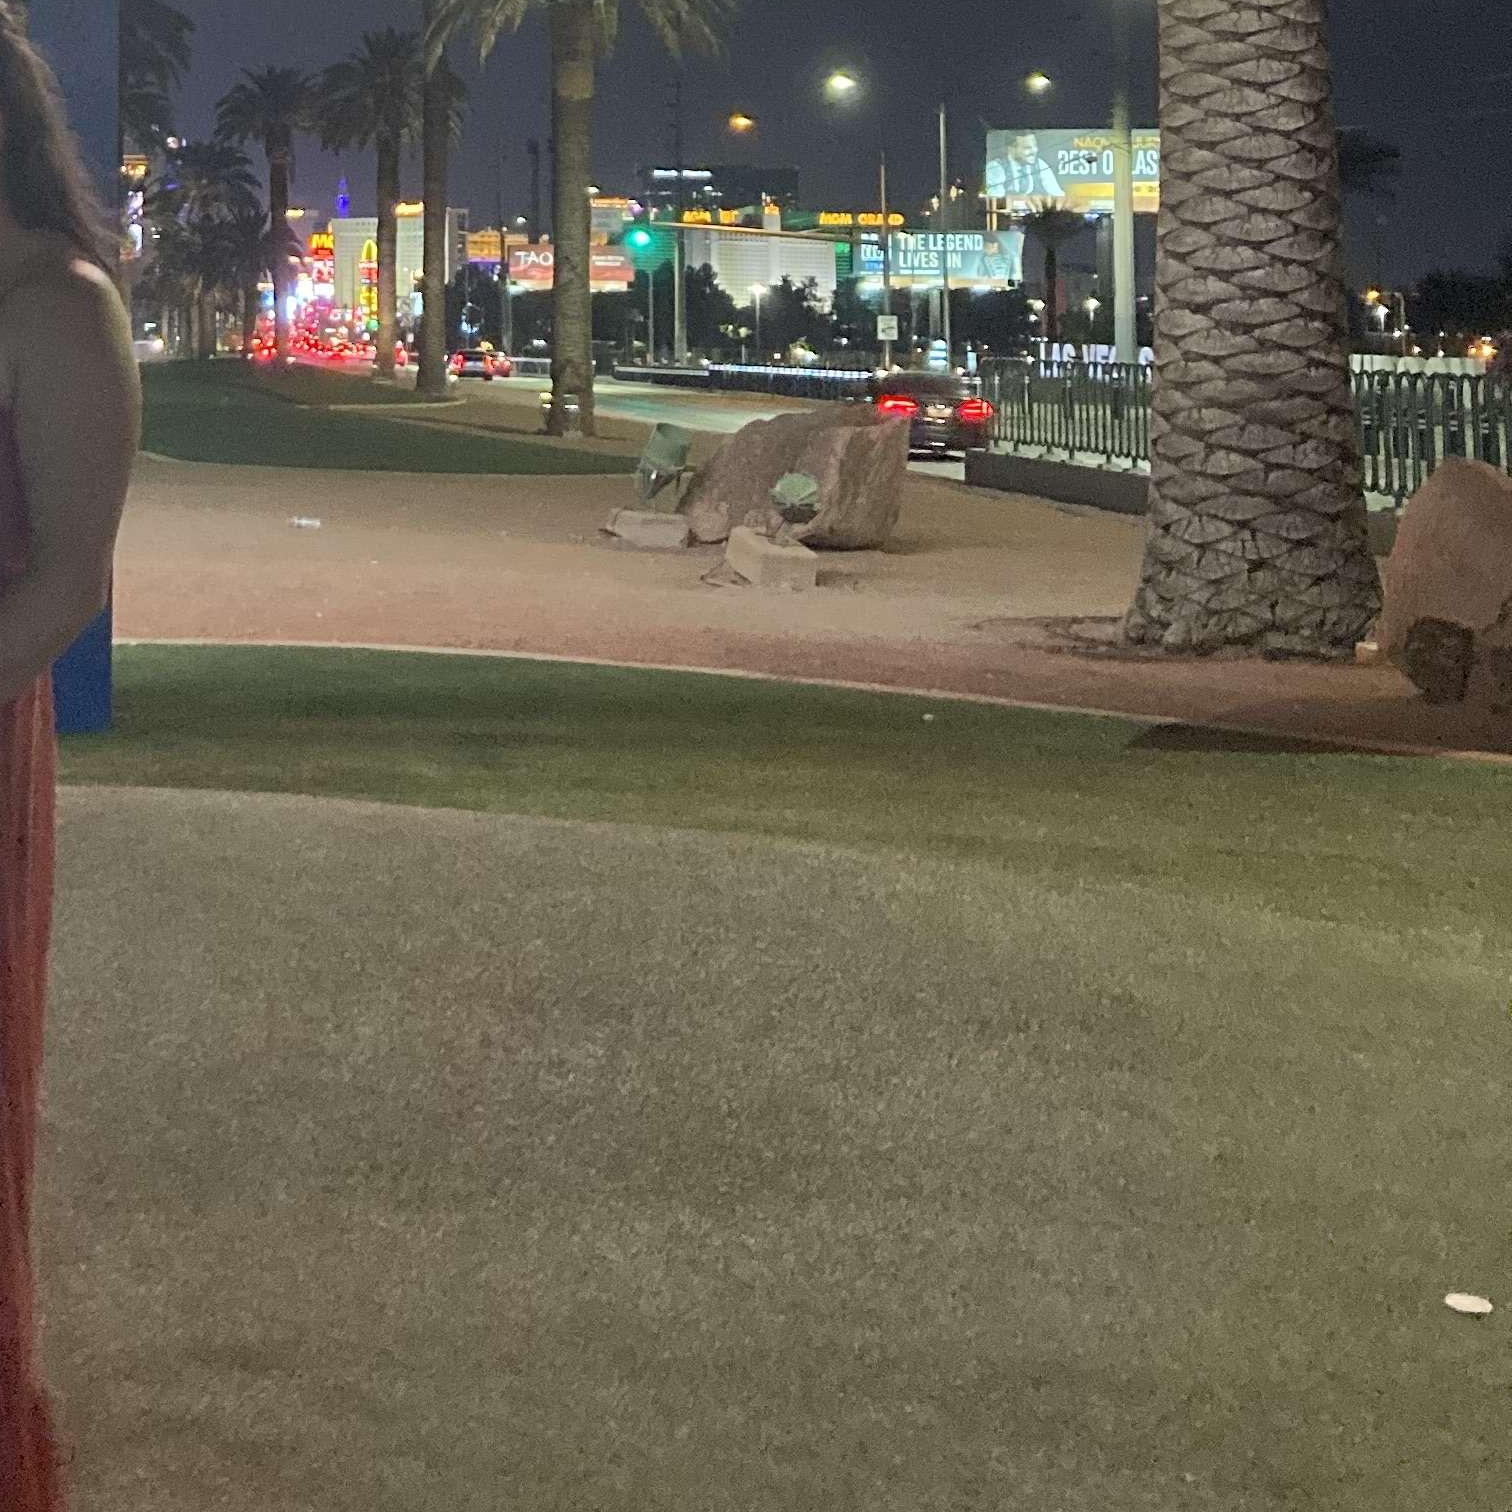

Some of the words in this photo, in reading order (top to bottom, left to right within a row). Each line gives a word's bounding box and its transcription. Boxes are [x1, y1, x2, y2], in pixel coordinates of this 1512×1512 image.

[900, 234, 925, 251] THE
[929, 234, 984, 251] LEGEND
[515, 251, 554, 267] TAO
[899, 252, 938, 268] LIVES
